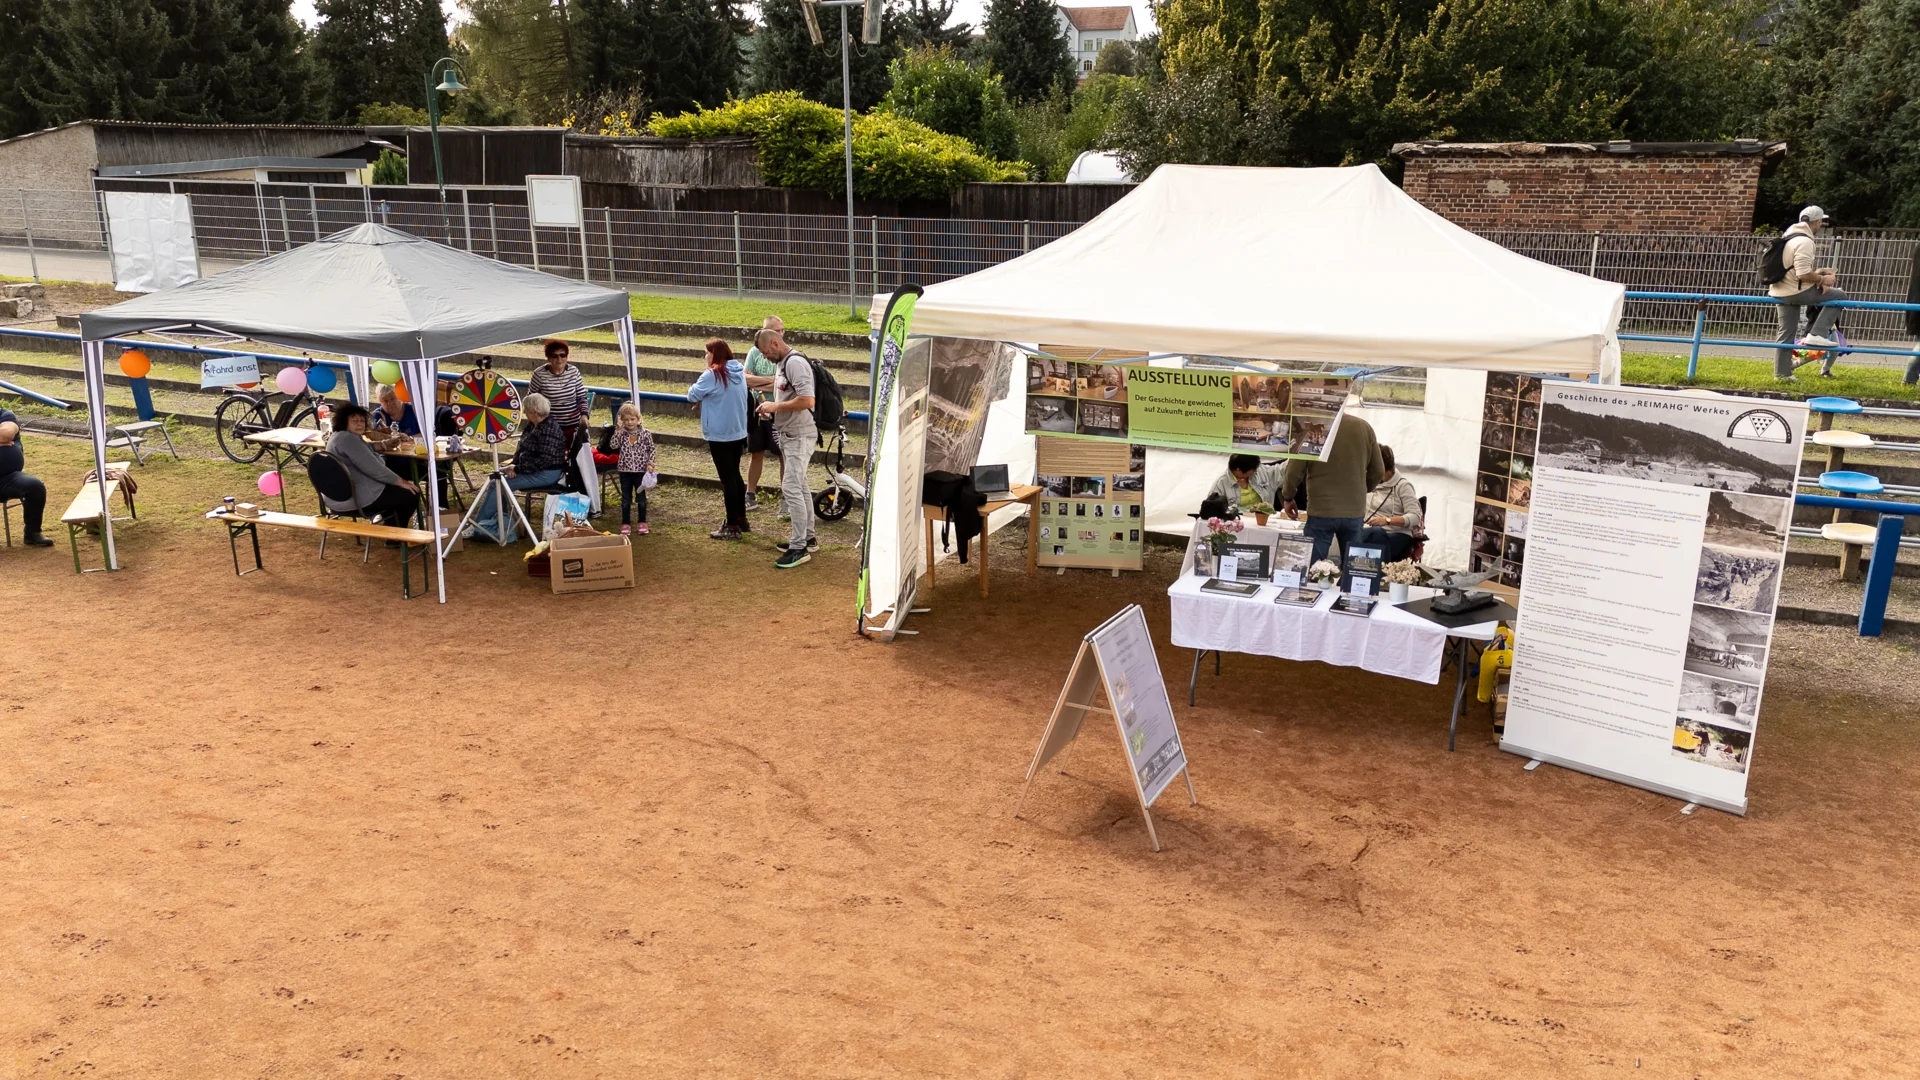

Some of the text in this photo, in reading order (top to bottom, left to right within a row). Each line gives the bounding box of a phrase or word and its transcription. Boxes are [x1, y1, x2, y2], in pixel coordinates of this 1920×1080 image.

[1128, 369, 1231, 388] AUSSTELLUNG
[1148, 395, 1186, 405] Geschichte
[1188, 398, 1226, 408] gewidmet,
[1557, 392, 1608, 404] Geschichte
[1612, 396, 1628, 406] des
[1693, 405, 1730, 416] Werkes
[1157, 407, 1183, 415] Zukunft
[1185, 410, 1216, 418] gerichtet
